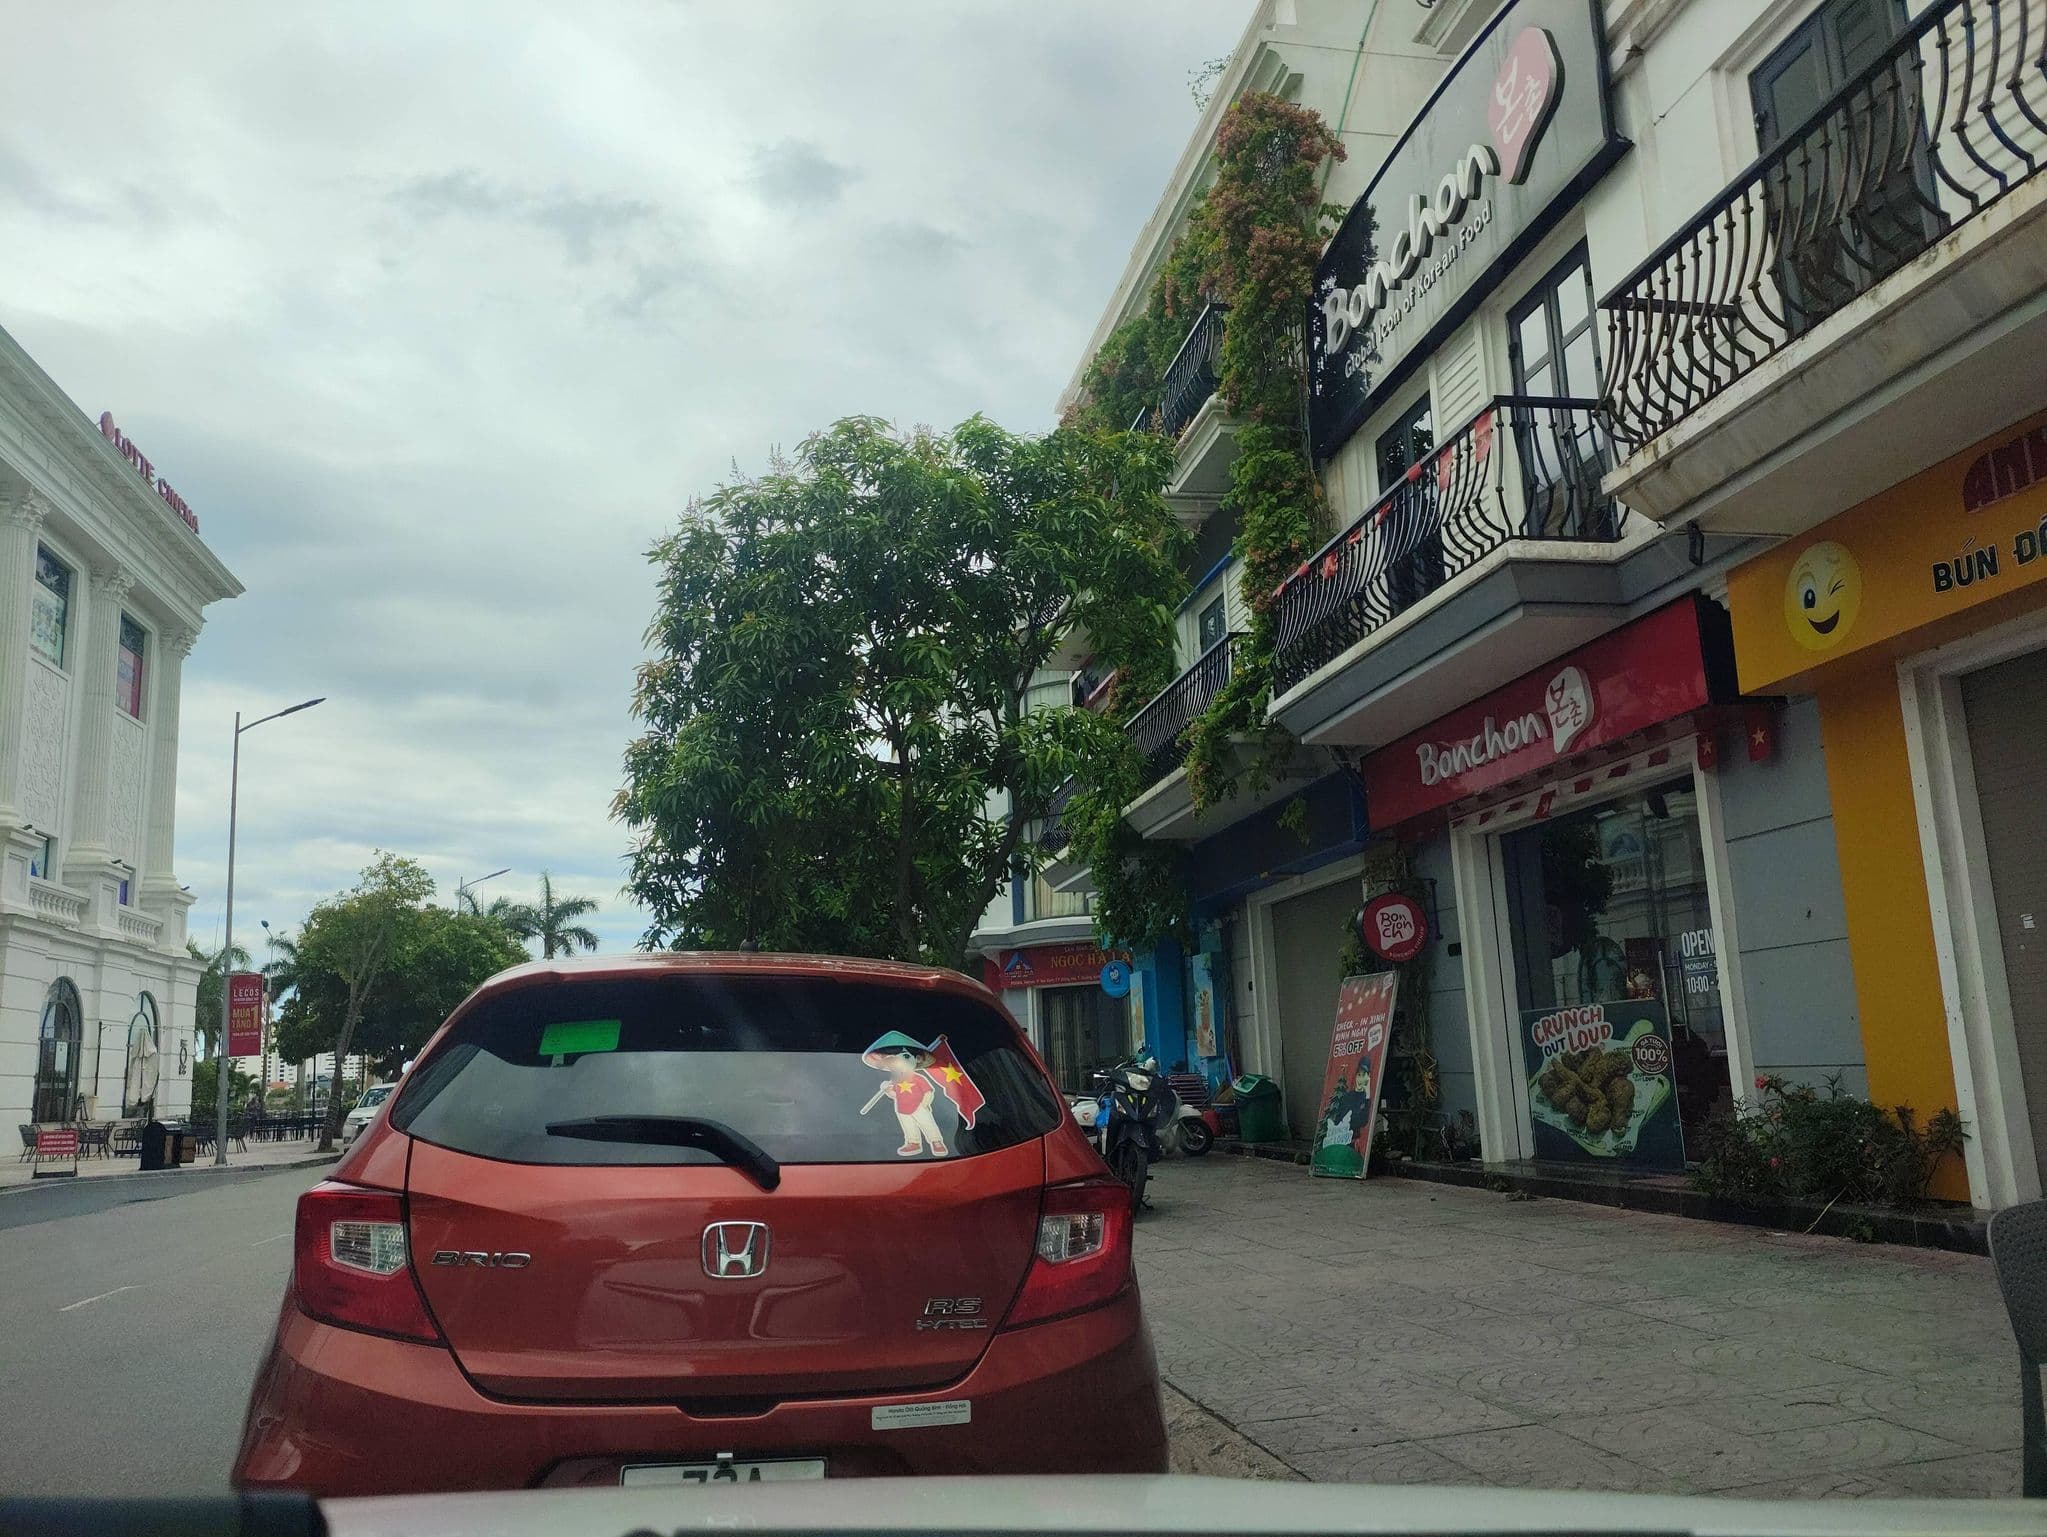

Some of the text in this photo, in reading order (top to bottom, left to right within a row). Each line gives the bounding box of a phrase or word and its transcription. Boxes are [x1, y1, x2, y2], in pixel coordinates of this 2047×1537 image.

[1322, 144, 1500, 355] Bonchon
[1344, 200, 1492, 379] Global Icon of Korean Food
[114, 427, 155, 482] LOTTE
[1932, 536, 2000, 593] BÚN
[1416, 711, 1548, 786] Bonchon
[1681, 929, 1715, 957] OPEN
[1685, 961, 1709, 970] MONDAY
[1687, 975, 1709, 993] 10:00
[1532, 1005, 1603, 1046] CRUNCH
[1544, 1023, 1613, 1057] OUT LOUD
[1634, 1047, 1668, 1062] 100%
[431, 1250, 531, 1268] BRIO
[924, 1297, 982, 1314] RS
